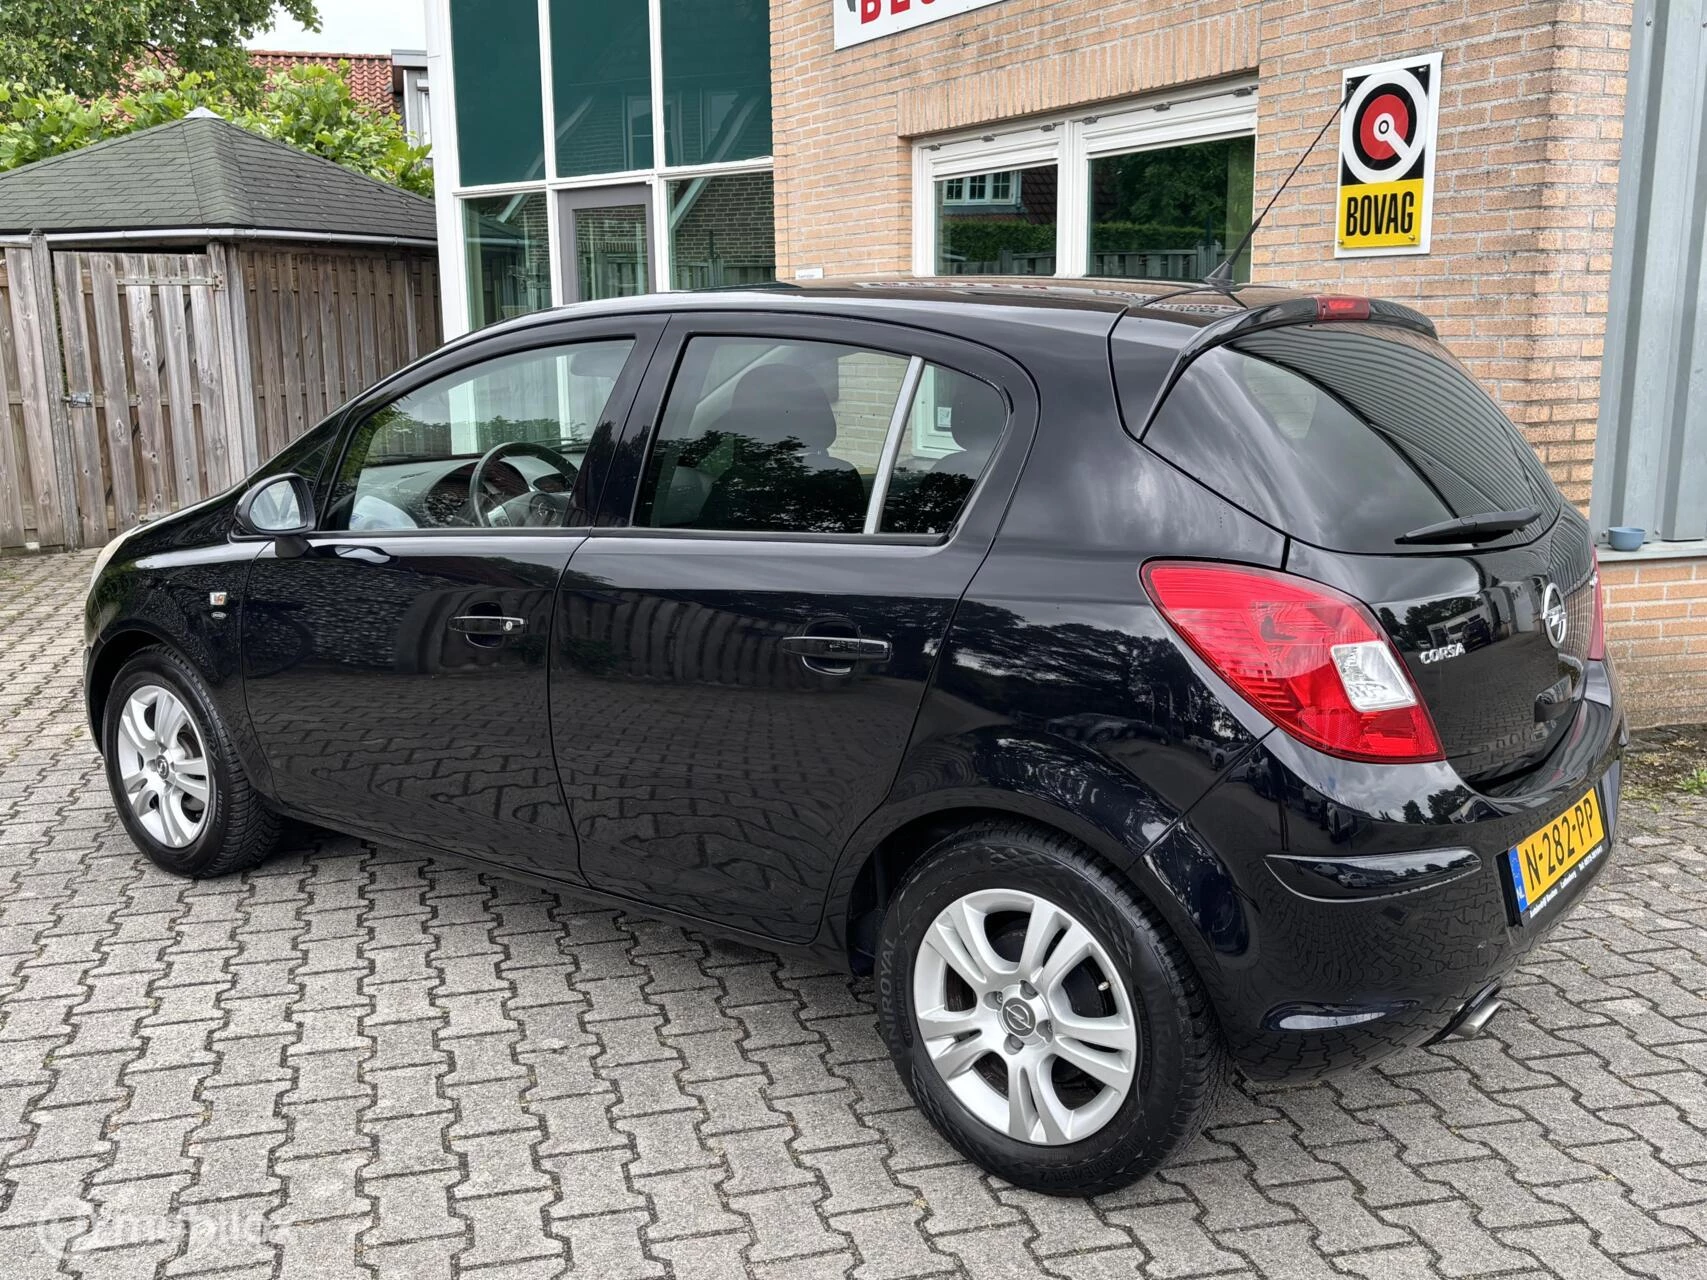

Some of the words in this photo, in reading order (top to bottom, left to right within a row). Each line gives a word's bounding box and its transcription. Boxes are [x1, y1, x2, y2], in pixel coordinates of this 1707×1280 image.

[1346, 191, 1415, 237] BOVAG
[1419, 642, 1467, 665] CORSA
[1524, 797, 1593, 892] N-282-PP
